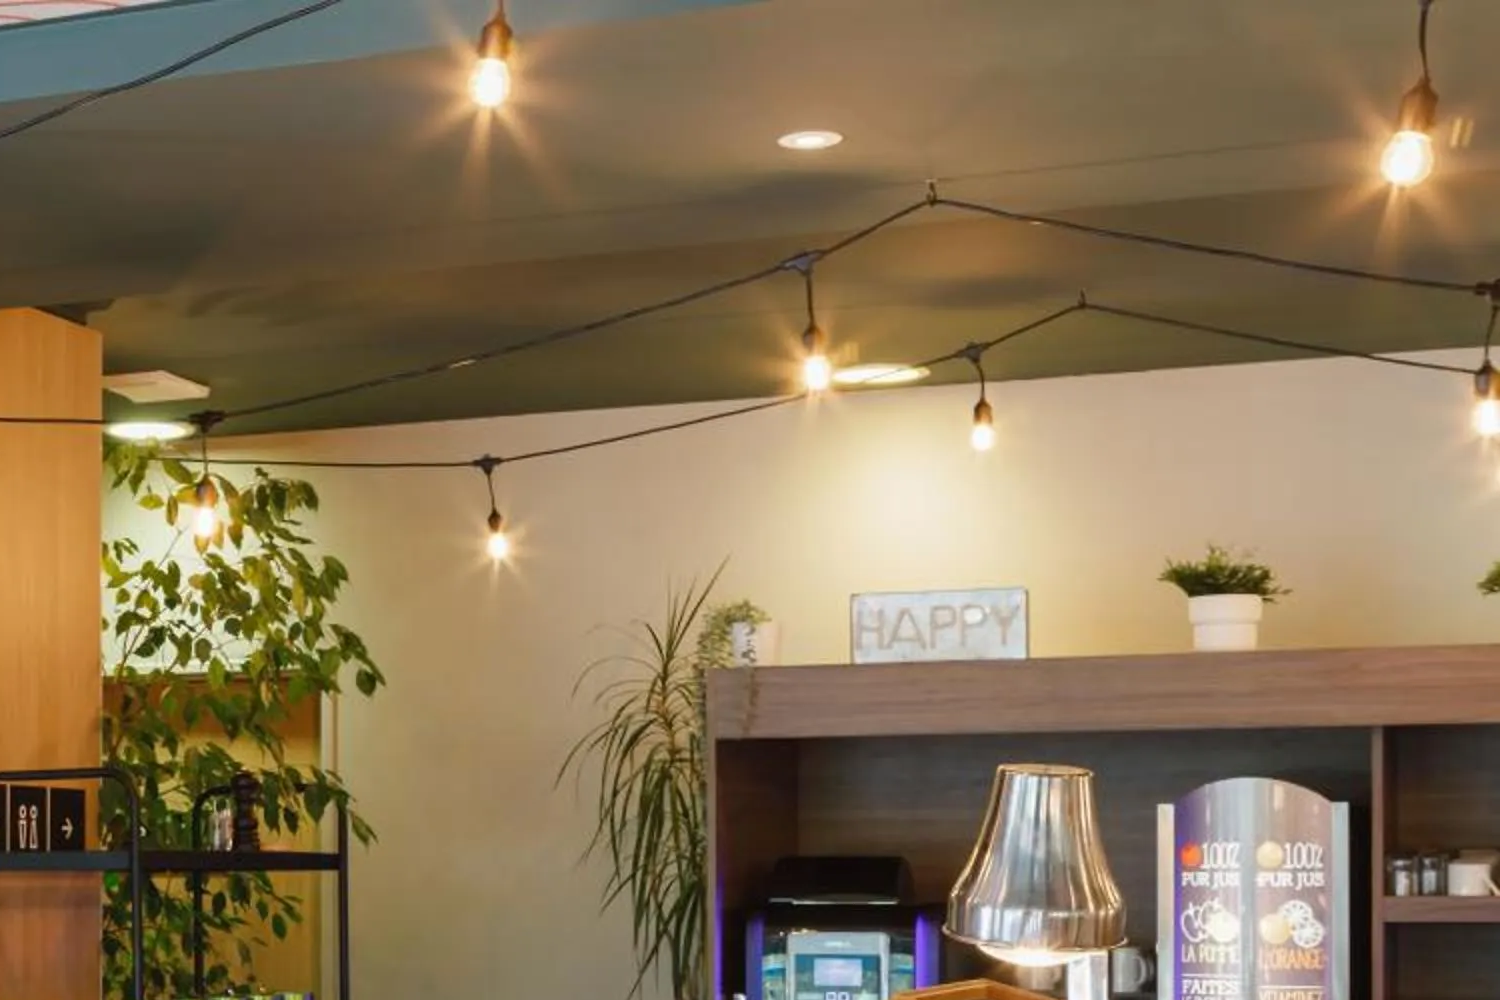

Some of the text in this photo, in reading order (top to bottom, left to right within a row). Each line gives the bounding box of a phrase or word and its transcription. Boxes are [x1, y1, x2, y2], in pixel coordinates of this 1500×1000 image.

[857, 603, 1021, 651] HAPPY
[1202, 842, 1241, 869] 100%
[1283, 842, 1324, 869] 100%
[1181, 871, 1241, 890] PUR JUS
[1257, 871, 1324, 891] PUR JUS
[1182, 944, 1197, 963] LA
[1181, 979, 1240, 995] FAITES
